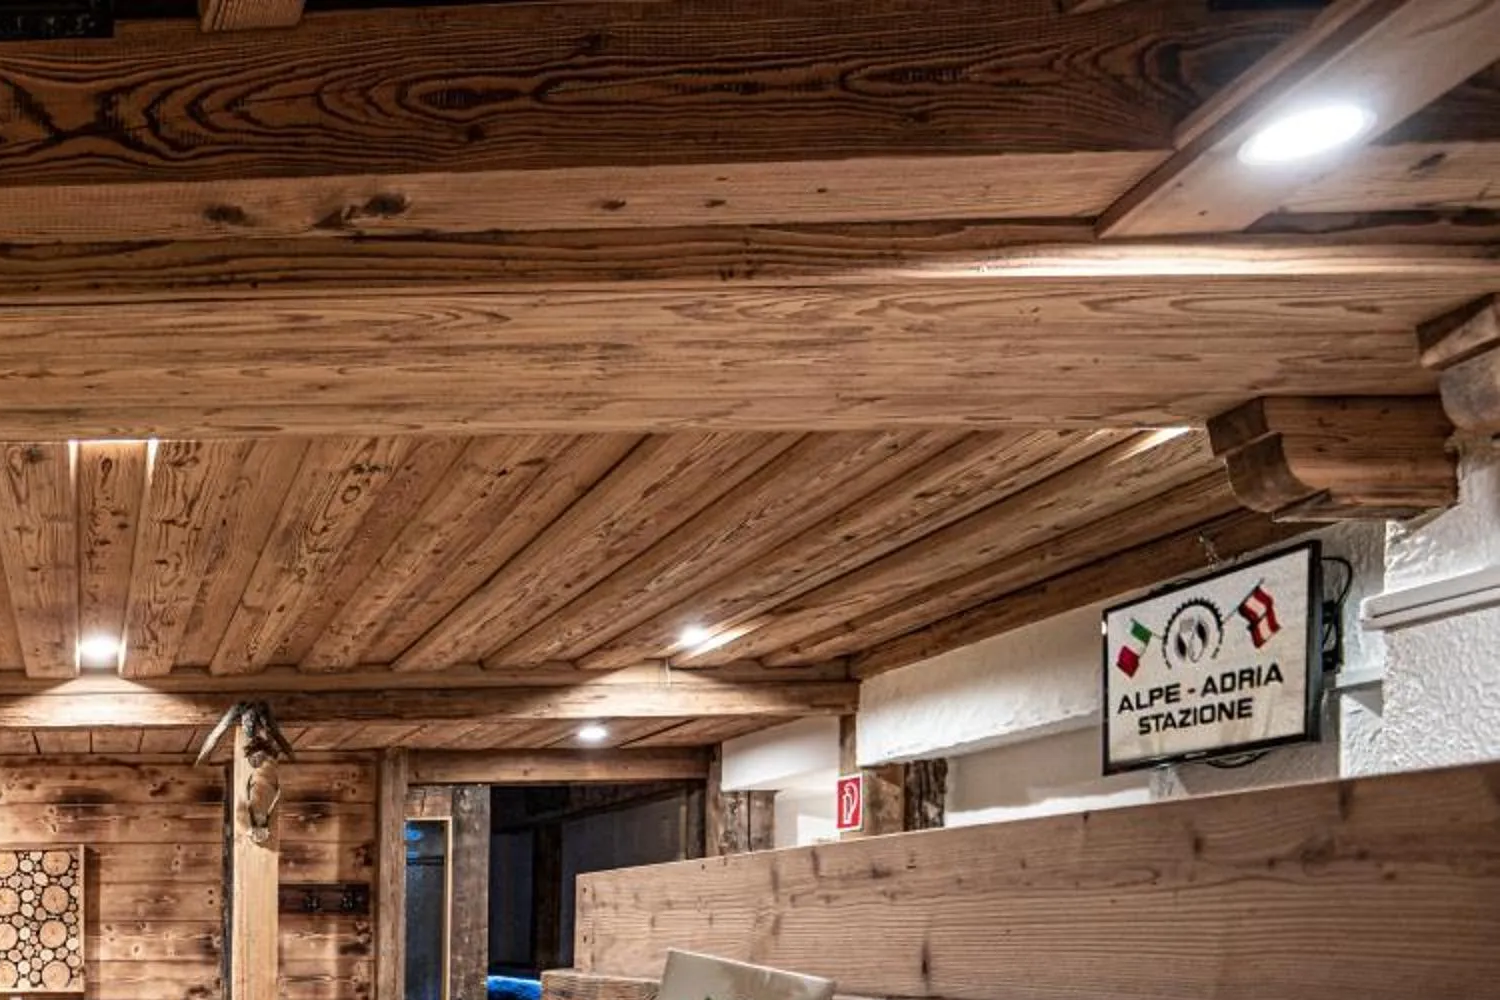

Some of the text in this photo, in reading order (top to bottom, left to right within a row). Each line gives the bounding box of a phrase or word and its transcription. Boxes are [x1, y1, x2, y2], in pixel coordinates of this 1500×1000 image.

[1117, 683, 1181, 714] ALPE
[1201, 662, 1284, 697] ADRIA
[1138, 698, 1254, 736] STAZIONE
